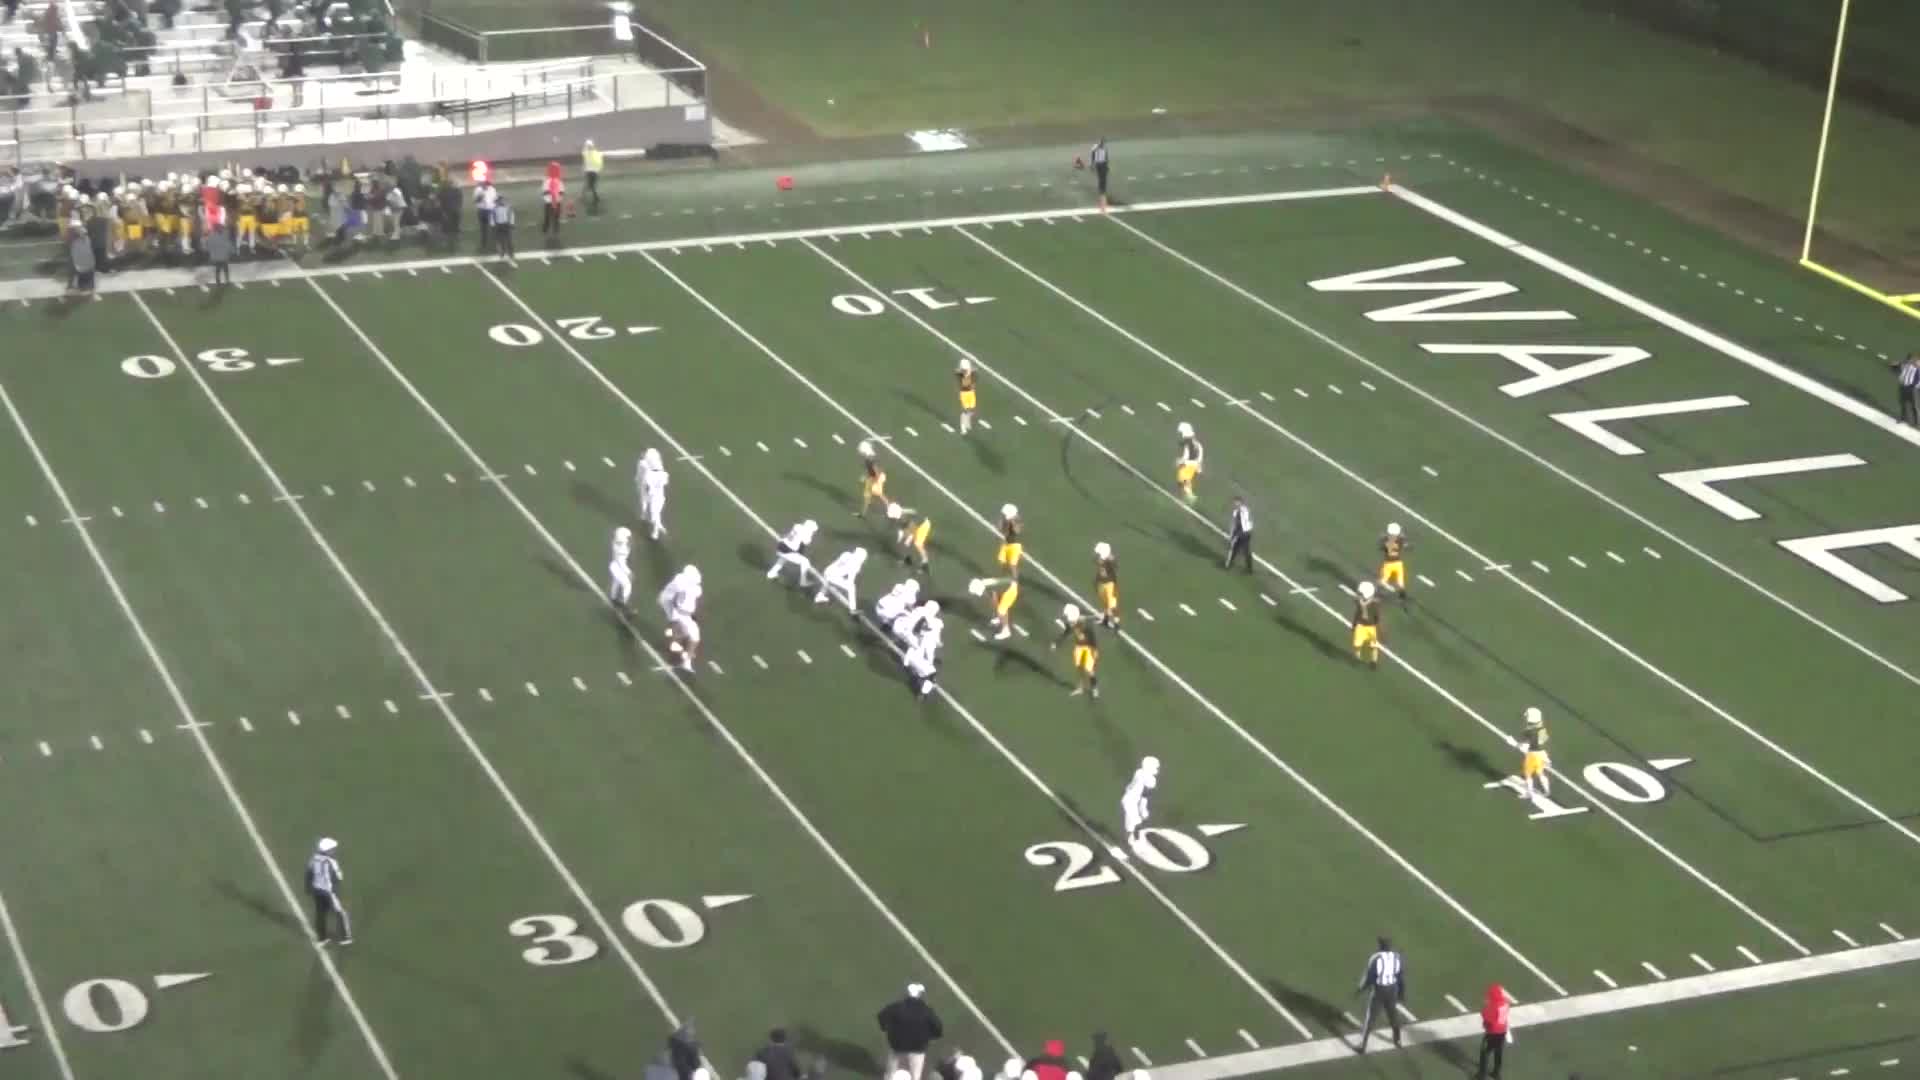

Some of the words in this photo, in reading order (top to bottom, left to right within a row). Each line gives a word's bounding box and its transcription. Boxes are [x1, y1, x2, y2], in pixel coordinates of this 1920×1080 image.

[831, 287, 960, 316] 10
[488, 316, 616, 346] 20
[120, 347, 256, 378] 30
[1484, 762, 1665, 820] 10
[1025, 828, 1210, 890] 20
[509, 899, 704, 966] 30
